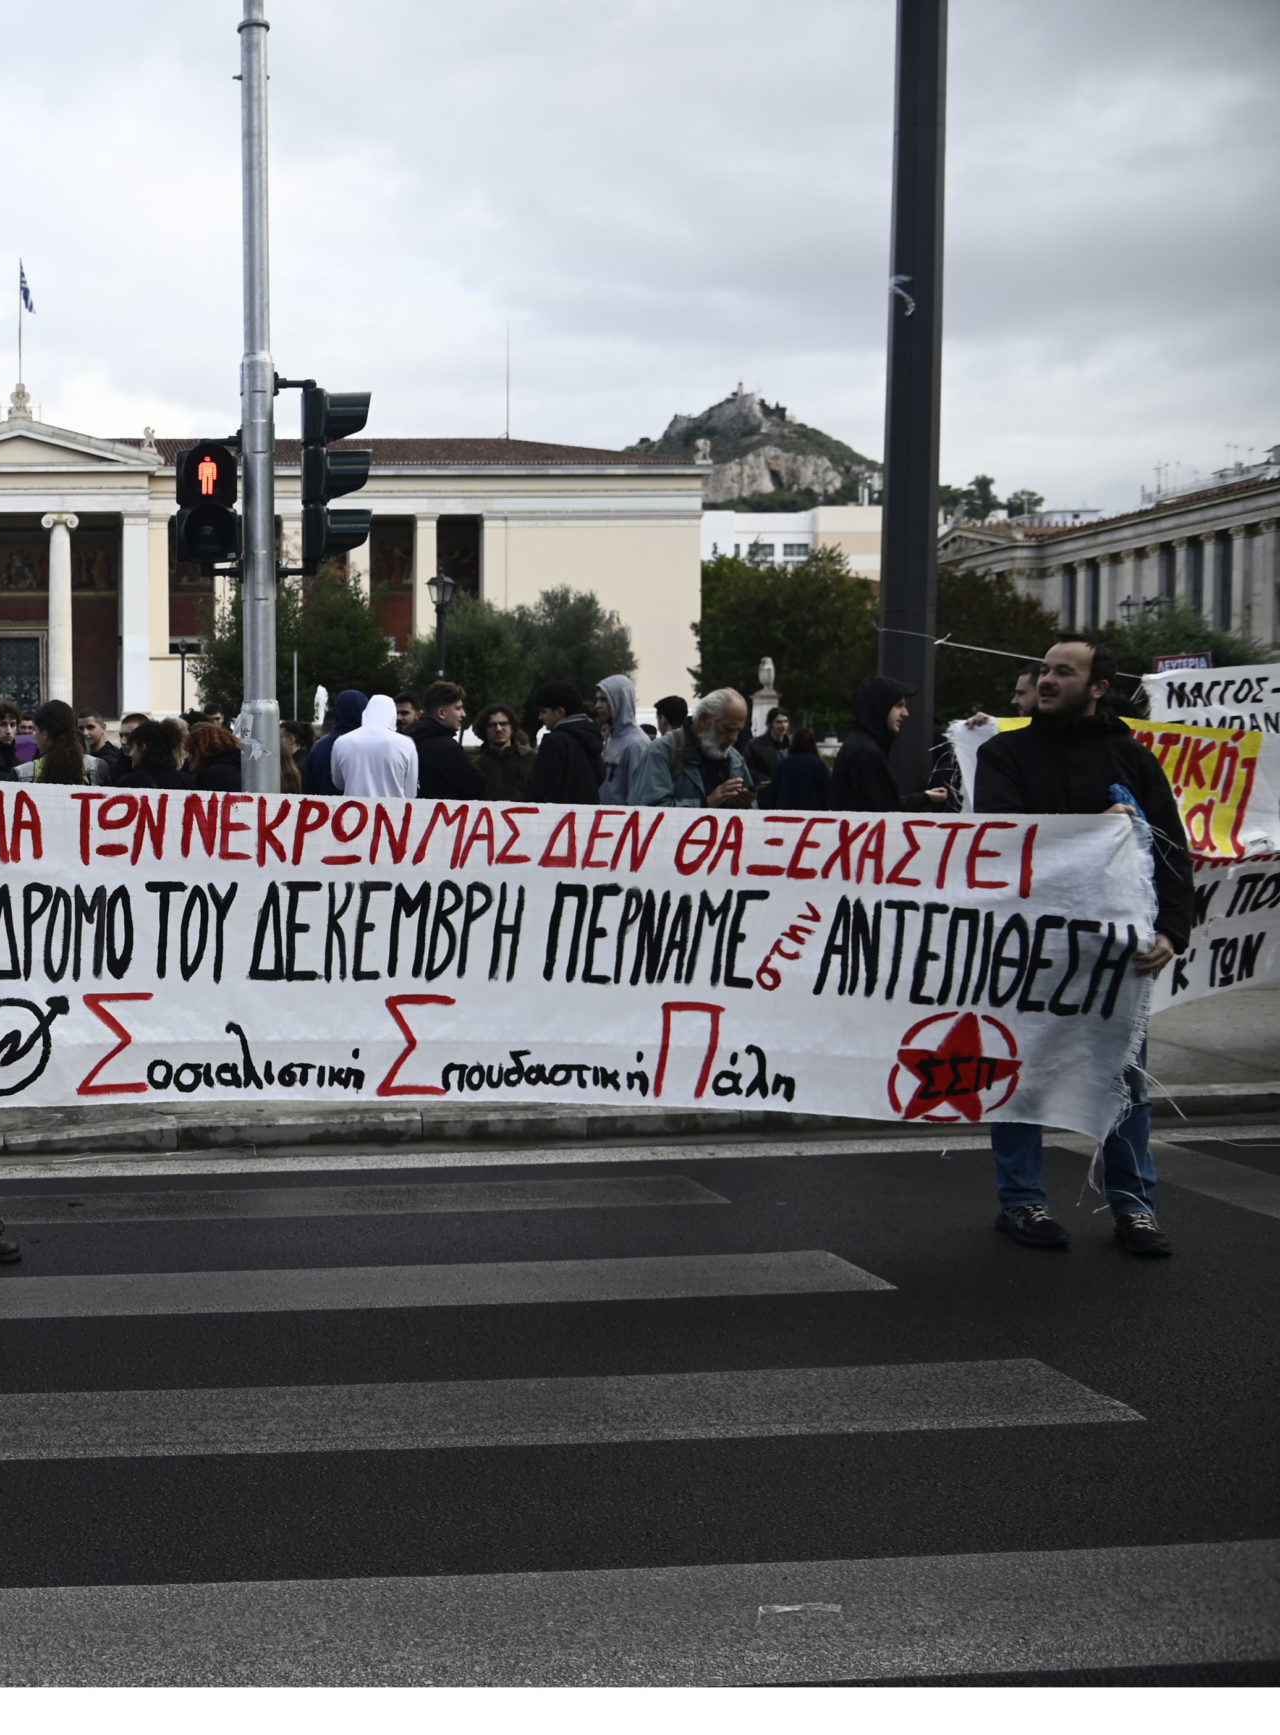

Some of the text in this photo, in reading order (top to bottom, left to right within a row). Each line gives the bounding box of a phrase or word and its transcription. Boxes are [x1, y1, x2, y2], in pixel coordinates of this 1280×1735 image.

[1166, 676, 1269, 709] ΜΑΓΓΟΣ
[71, 793, 168, 866] ΤΩΝ
[181, 793, 412, 867] ΝΕΚΡΩΝ
[413, 802, 539, 869] ΜΑΣ
[539, 808, 664, 873] ΔΕΝ
[675, 814, 744, 876] ΘΑ
[746, 816, 1037, 898] ΞΕΧΑΣΤΕΙ
[146, 881, 237, 983] ΤΟΥ
[249, 879, 524, 983] ΔΕΚΕΜΒΡΗ
[543, 882, 769, 990] ΠΕΡΝΑΜΕ
[756, 902, 822, 991] στην
[813, 895, 1139, 1019] ΑΝΤΕΠΙΘΕΣΗ
[1209, 931, 1266, 988] ΤΩΝ
[77, 992, 796, 1104] Σοσιαλιστική Σπουδαστική Πάλη
[920, 1054, 998, 1099] ΣΣΠ
